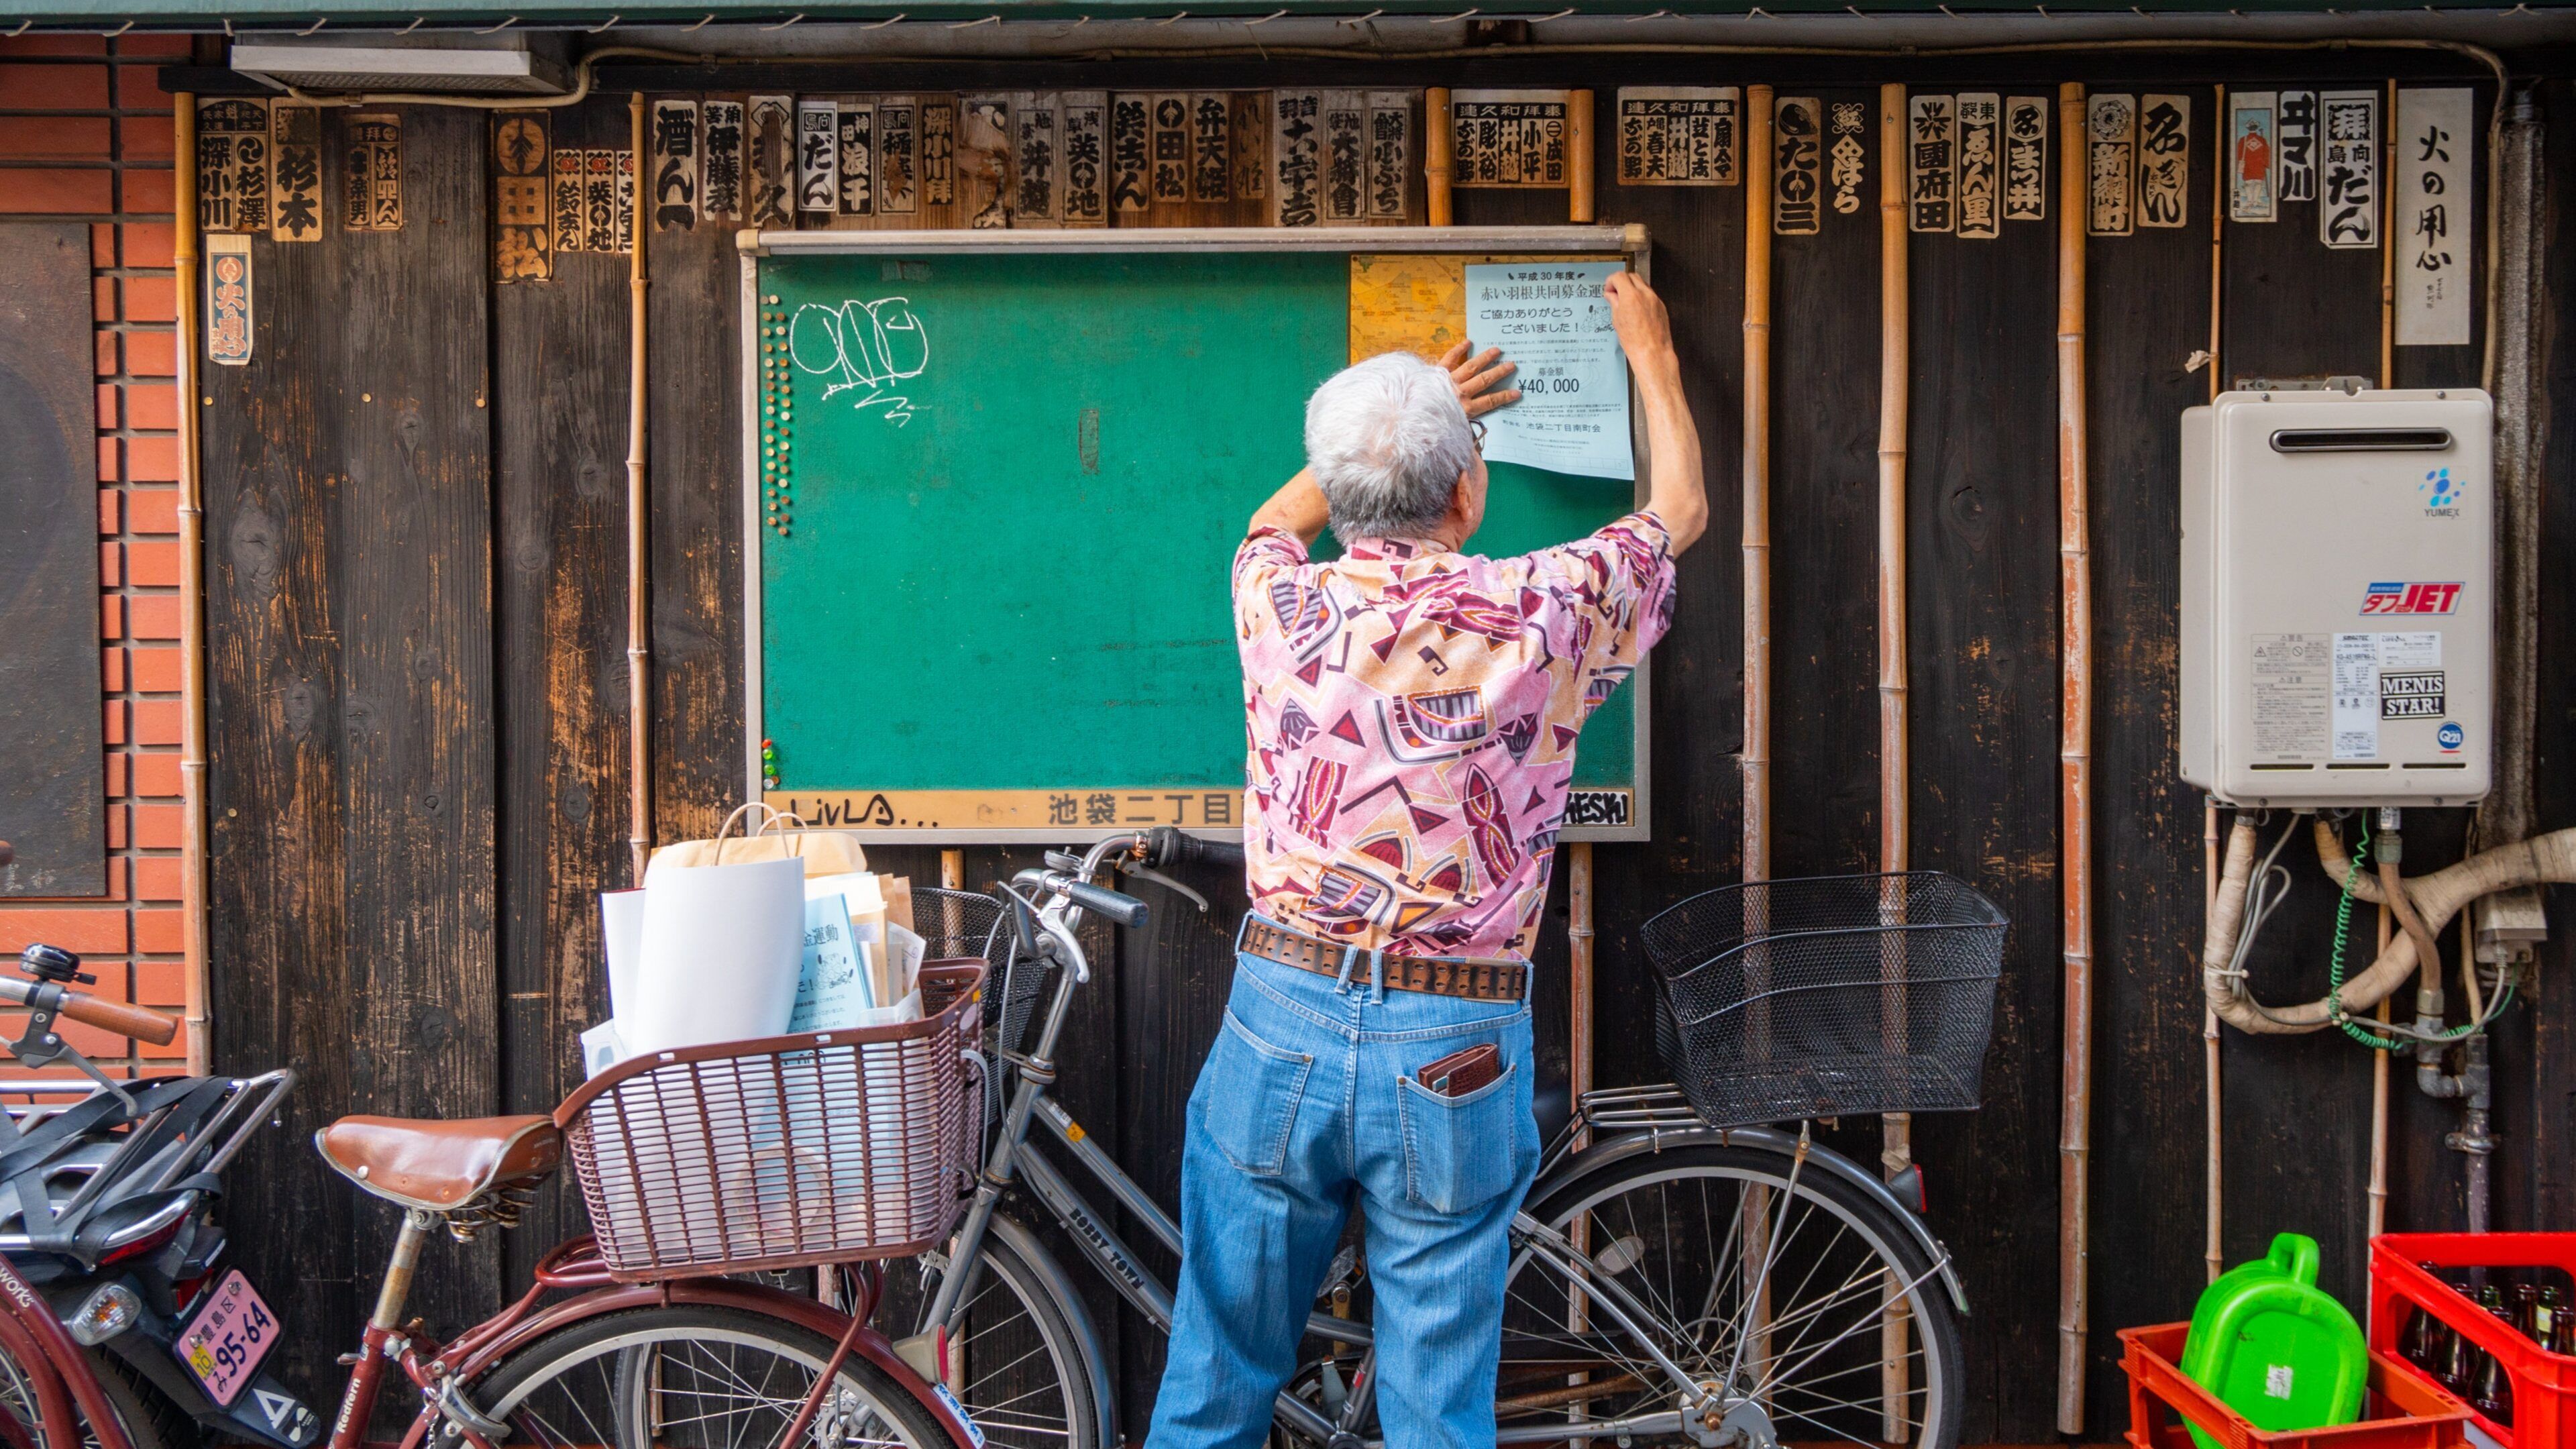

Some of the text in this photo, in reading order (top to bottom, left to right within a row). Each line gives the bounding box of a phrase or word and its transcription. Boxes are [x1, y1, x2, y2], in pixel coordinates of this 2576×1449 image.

[277, 146, 317, 238] 杉本
[2416, 125, 2452, 272] 火の用心
[1481, 282, 1605, 301] 赤い羽根共同募金運
[1480, 307, 1573, 320] ご協力ありがとう
[2424, 508, 2460, 519] YUMEX
[2382, 676, 2444, 694] MENIS
[2386, 697, 2440, 715] STAR!
[1049, 793, 1245, 826] 池袋二丁目
[200, 1295, 236, 1344] 豊島区
[216, 1300, 272, 1377] 95-64
[336, 1377, 362, 1434] Redfern
